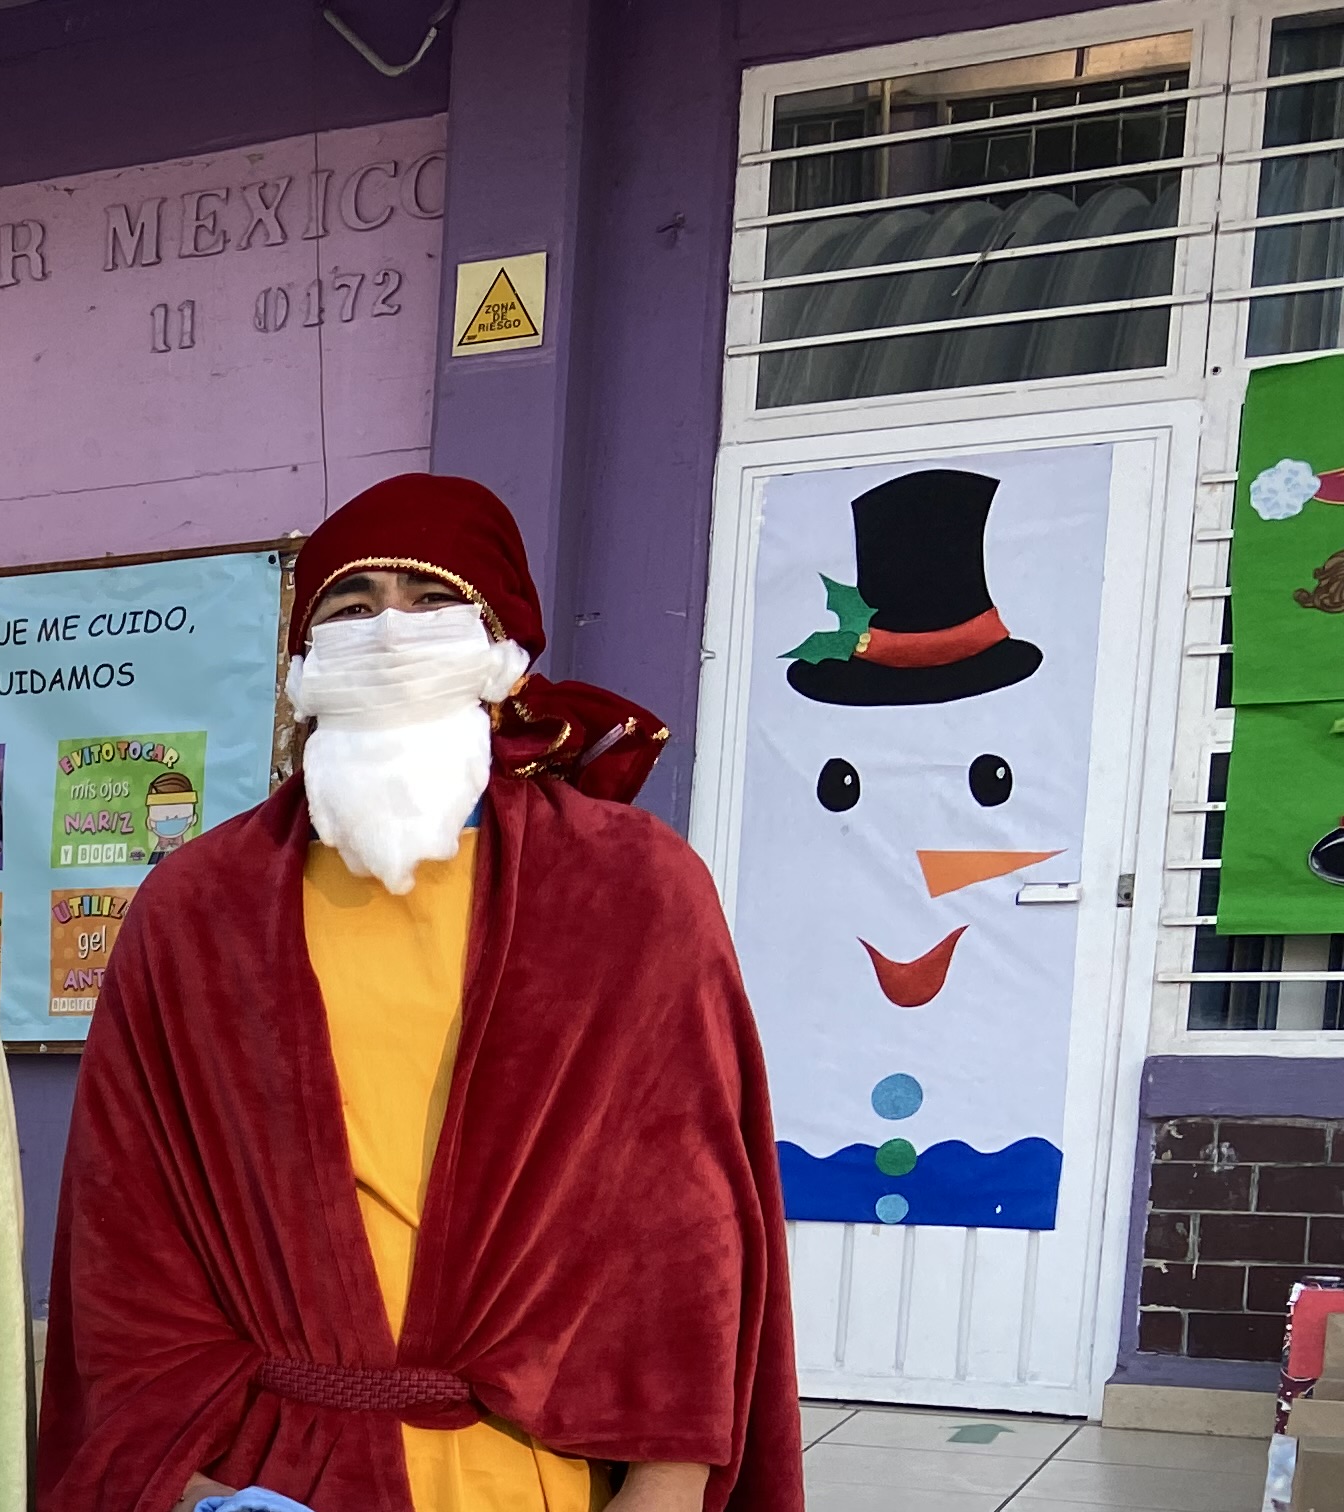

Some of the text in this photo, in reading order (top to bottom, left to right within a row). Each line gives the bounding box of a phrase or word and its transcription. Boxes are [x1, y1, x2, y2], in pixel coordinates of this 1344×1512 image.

[484, 301, 517, 315] ZONA
[493, 311, 508, 323] DE
[37, 615, 81, 642] ME
[88, 605, 196, 637] CUIDO,
[58, 740, 180, 775] EVITO TOCAR
[70, 777, 131, 803] mis ojos
[64, 810, 135, 836] NARIZ
[62, 847, 72, 864] Y
[78, 844, 127, 864] BOCA
[78, 925, 106, 959] gel
[64, 968, 105, 991] ANT
[52, 998, 96, 1012] BACTE
